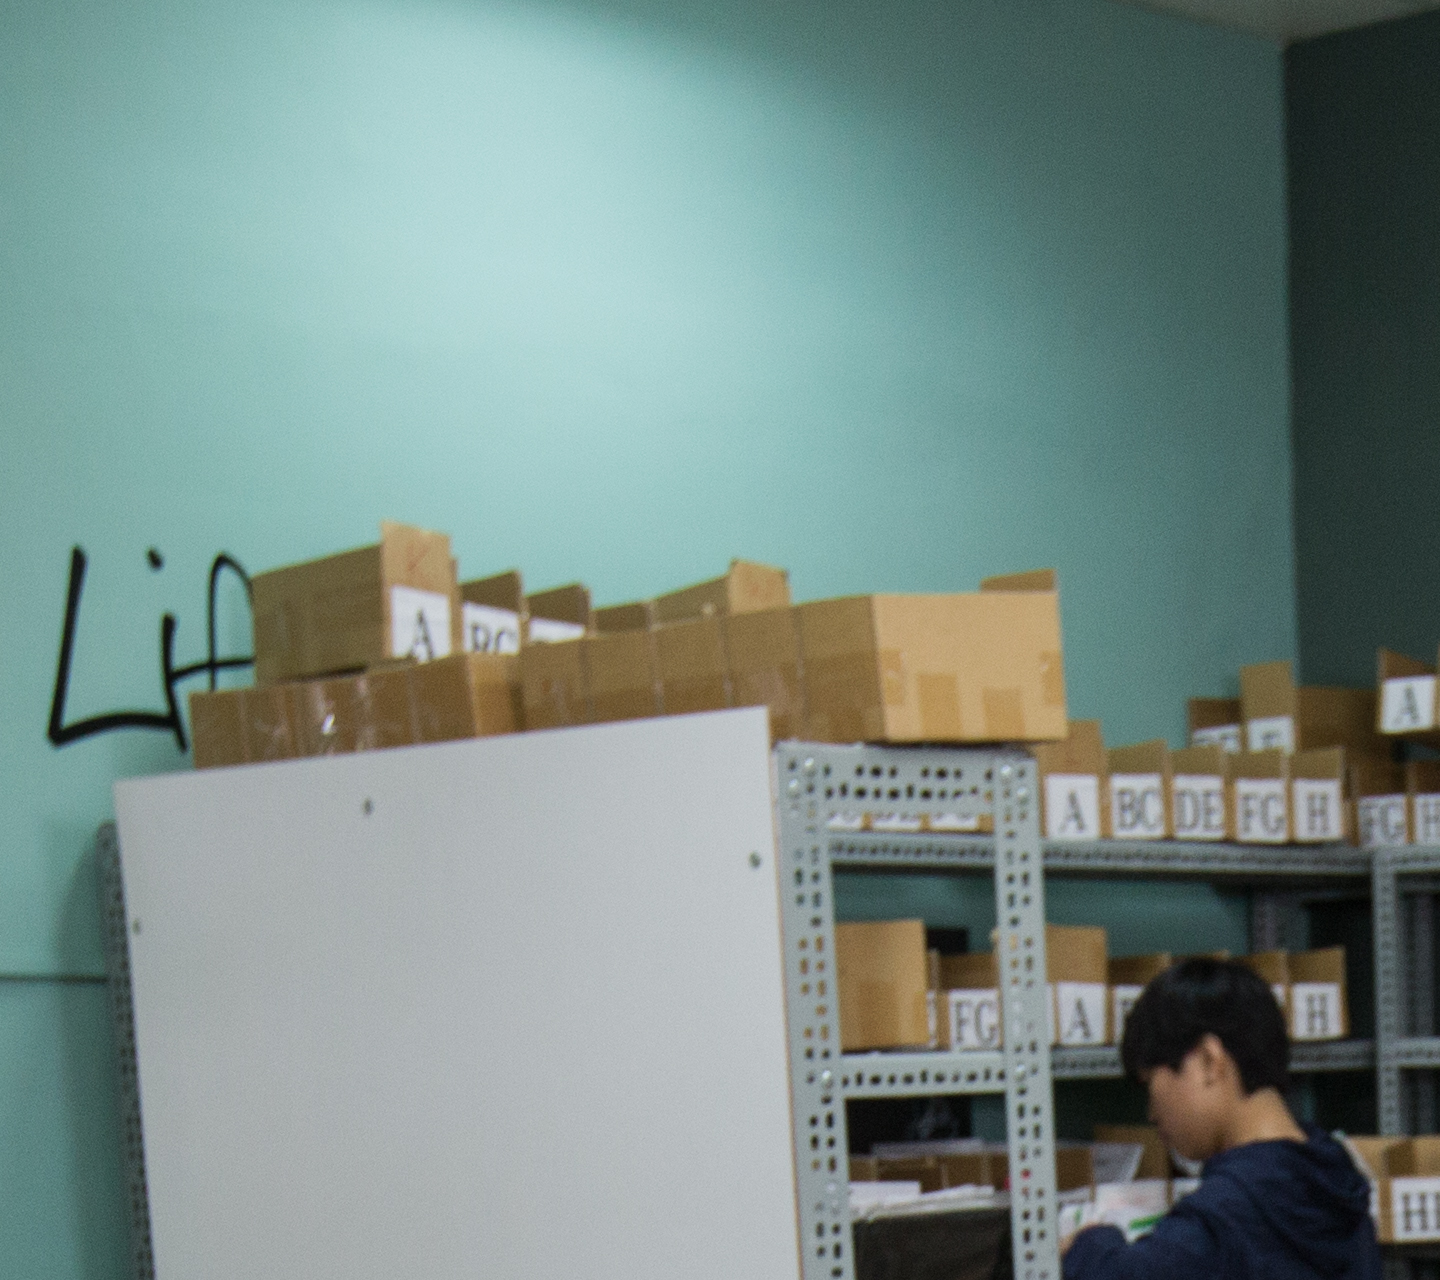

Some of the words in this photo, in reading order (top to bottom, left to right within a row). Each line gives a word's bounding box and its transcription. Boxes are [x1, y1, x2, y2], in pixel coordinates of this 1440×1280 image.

[408, 609, 437, 663] A
[1394, 683, 1420, 724] A
[1060, 790, 1086, 833] A
[1115, 788, 1162, 831] BC
[1175, 789, 1223, 831] DE
[1242, 793, 1285, 836] FG
[1307, 793, 1331, 834] H
[956, 1000, 998, 1045] FG
[1066, 998, 1091, 1040] A
[1307, 994, 1330, 1035] H
